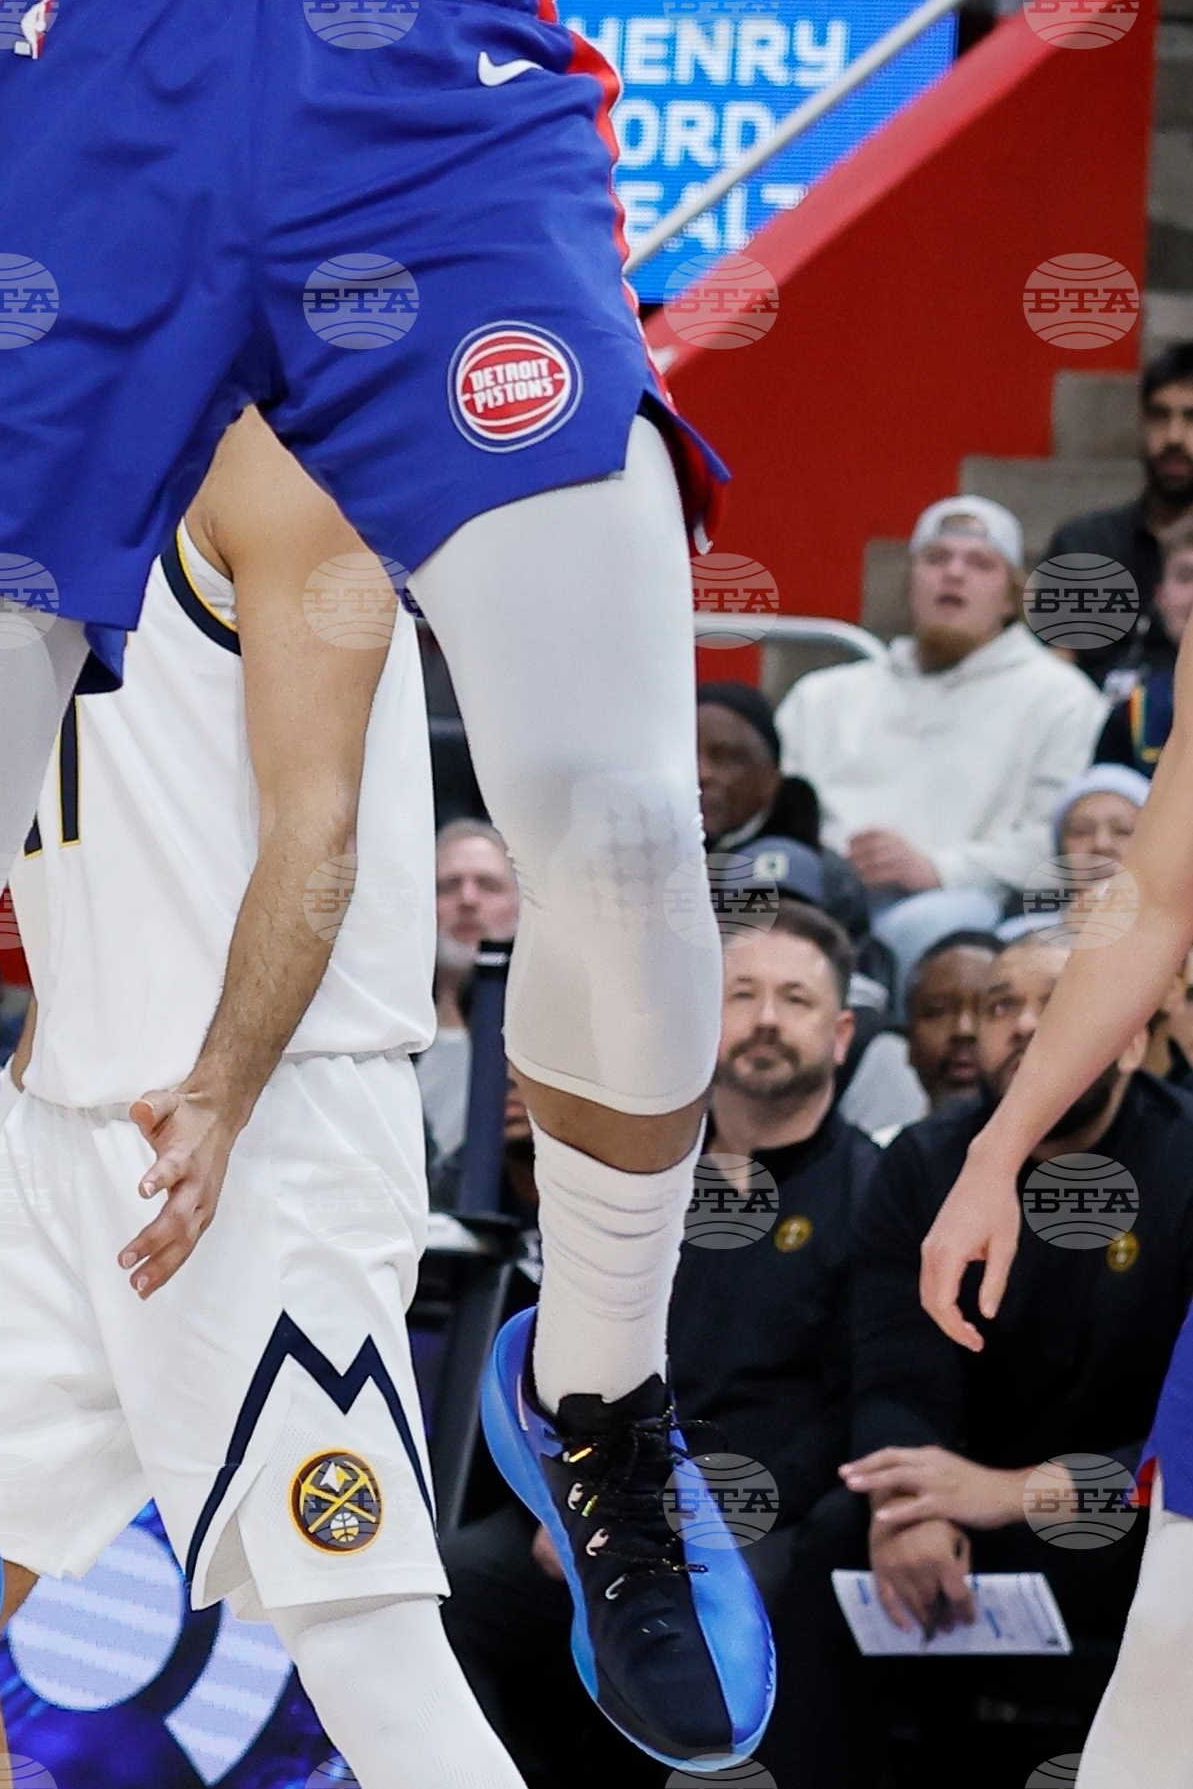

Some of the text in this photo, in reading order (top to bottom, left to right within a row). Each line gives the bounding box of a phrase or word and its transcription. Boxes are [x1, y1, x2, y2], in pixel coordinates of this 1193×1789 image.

[564, 16, 849, 88] HENRY
[612, 98, 780, 171] ORD
[468, 357, 550, 393] DETROIT
[472, 376, 555, 414] PISTONS
